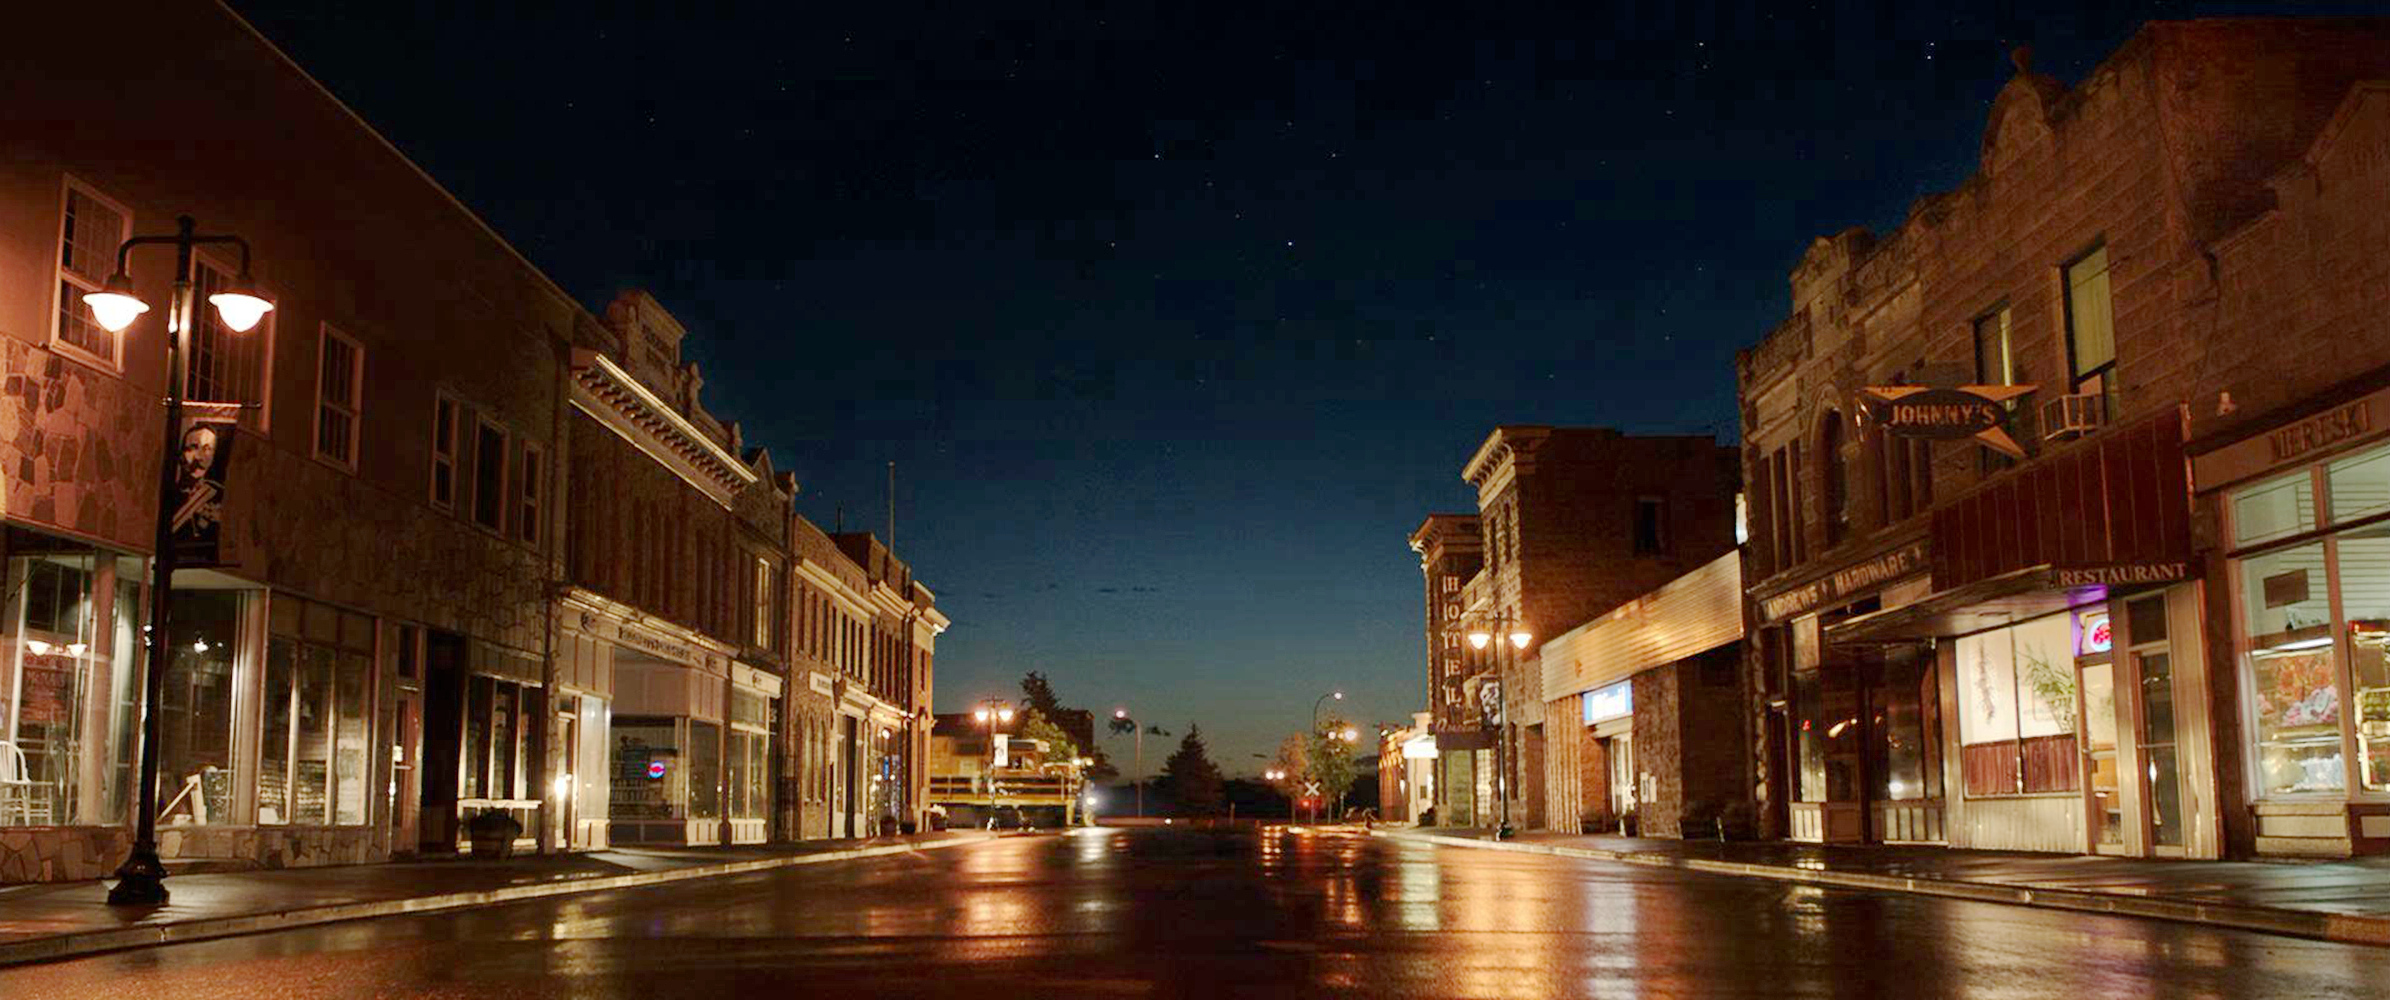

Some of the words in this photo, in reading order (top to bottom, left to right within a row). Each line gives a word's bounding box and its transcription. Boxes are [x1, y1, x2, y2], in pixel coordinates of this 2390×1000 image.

[1890, 403, 1995, 426] JOHNNY'S
[1764, 584, 1817, 621] ANDREWS
[1835, 550, 1911, 600] HARDWARE
[2059, 562, 2186, 587] RESTAURANT
[1443, 575, 1462, 707] HOTEL
